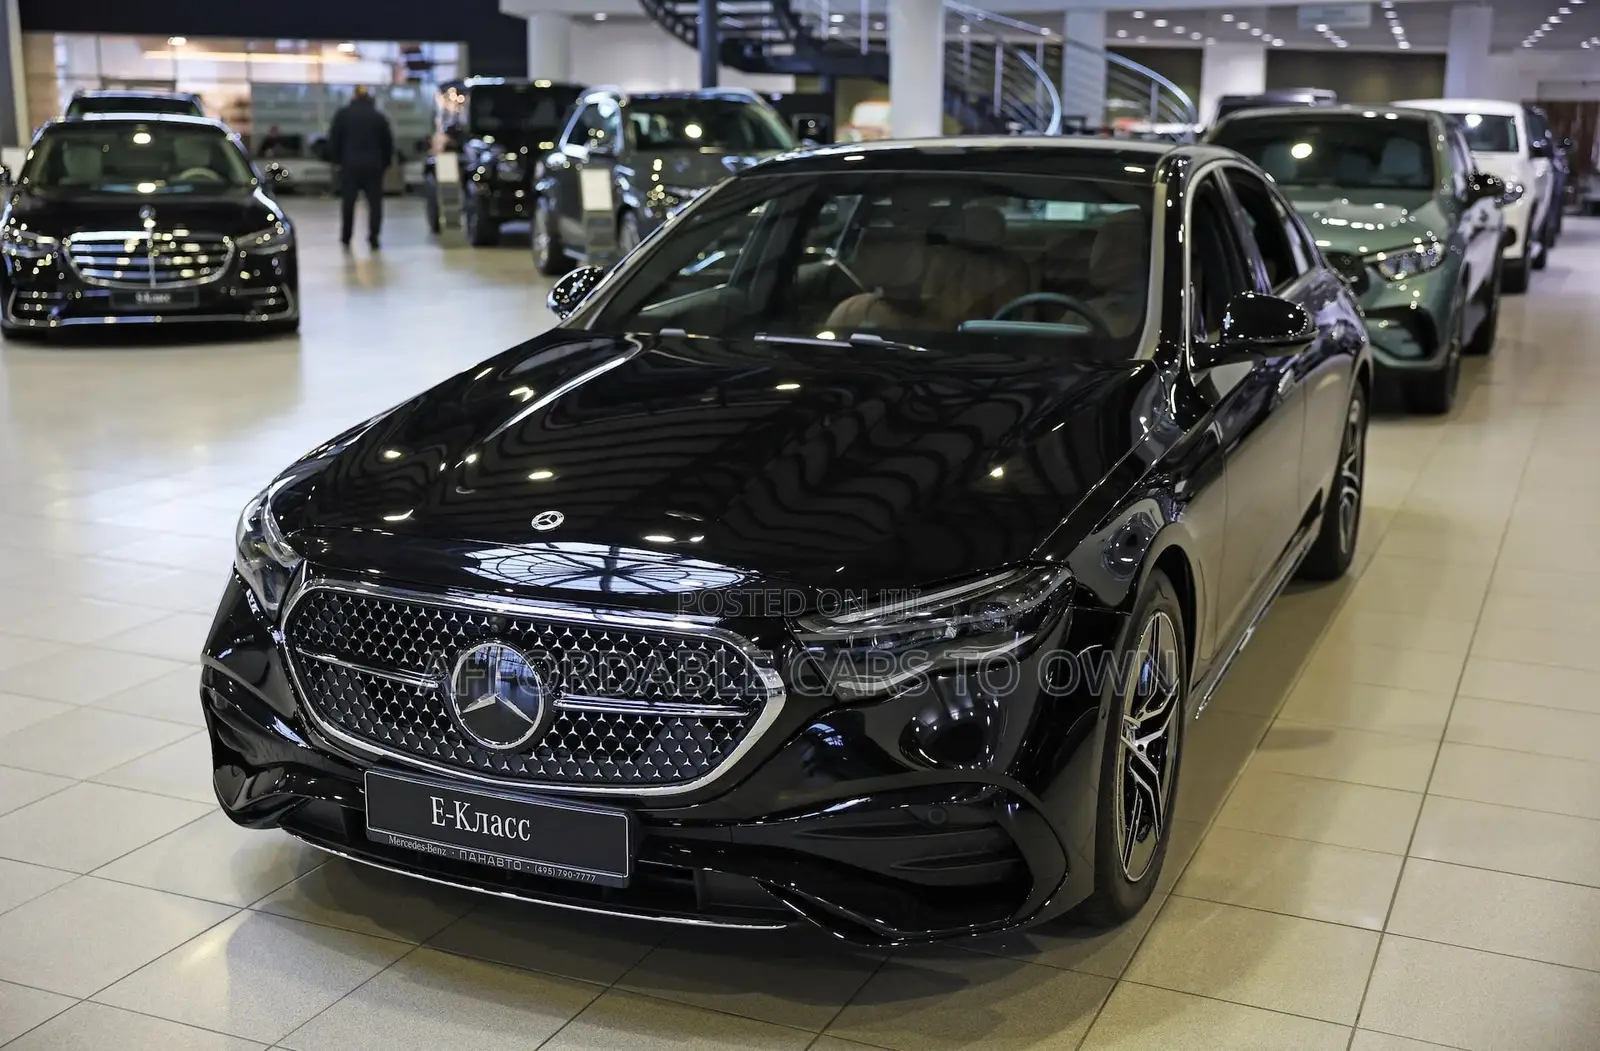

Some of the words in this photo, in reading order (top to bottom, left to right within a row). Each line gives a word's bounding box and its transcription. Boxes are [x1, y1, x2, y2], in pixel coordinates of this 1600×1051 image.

[430, 796, 531, 841] Е-Класс
[388, 835, 447, 856] Mercedes-Benz
[459, 850, 522, 871] ПАНАВТО
